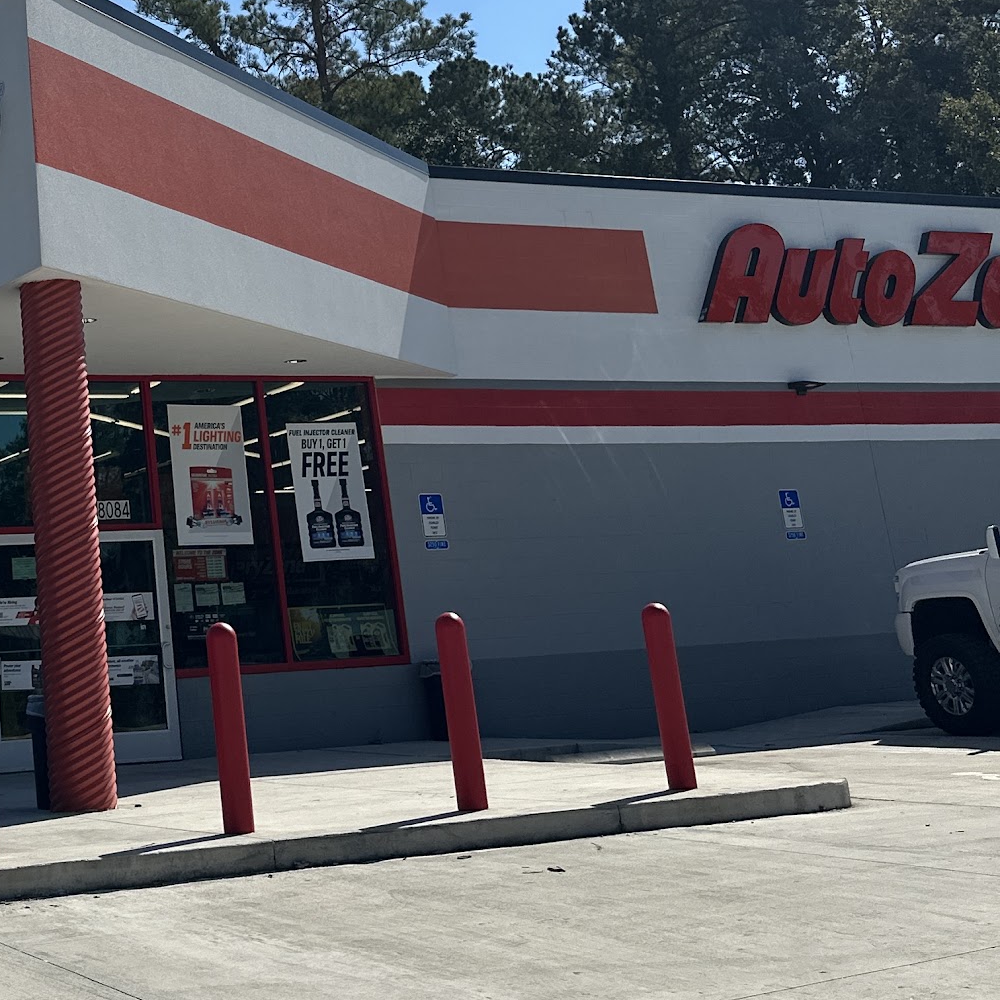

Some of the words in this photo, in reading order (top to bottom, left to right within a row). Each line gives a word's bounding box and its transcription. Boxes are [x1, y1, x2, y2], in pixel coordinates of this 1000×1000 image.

[194, 422, 226, 430] AMERICA'S
[171, 422, 192, 450] #1
[193, 430, 242, 443] LIGHTING
[301, 439, 319, 449] BUY
[326, 438, 342, 449] GET
[342, 438, 346, 449] 1
[301, 451, 349, 478] FREE
[98, 501, 130, 518] 8084
